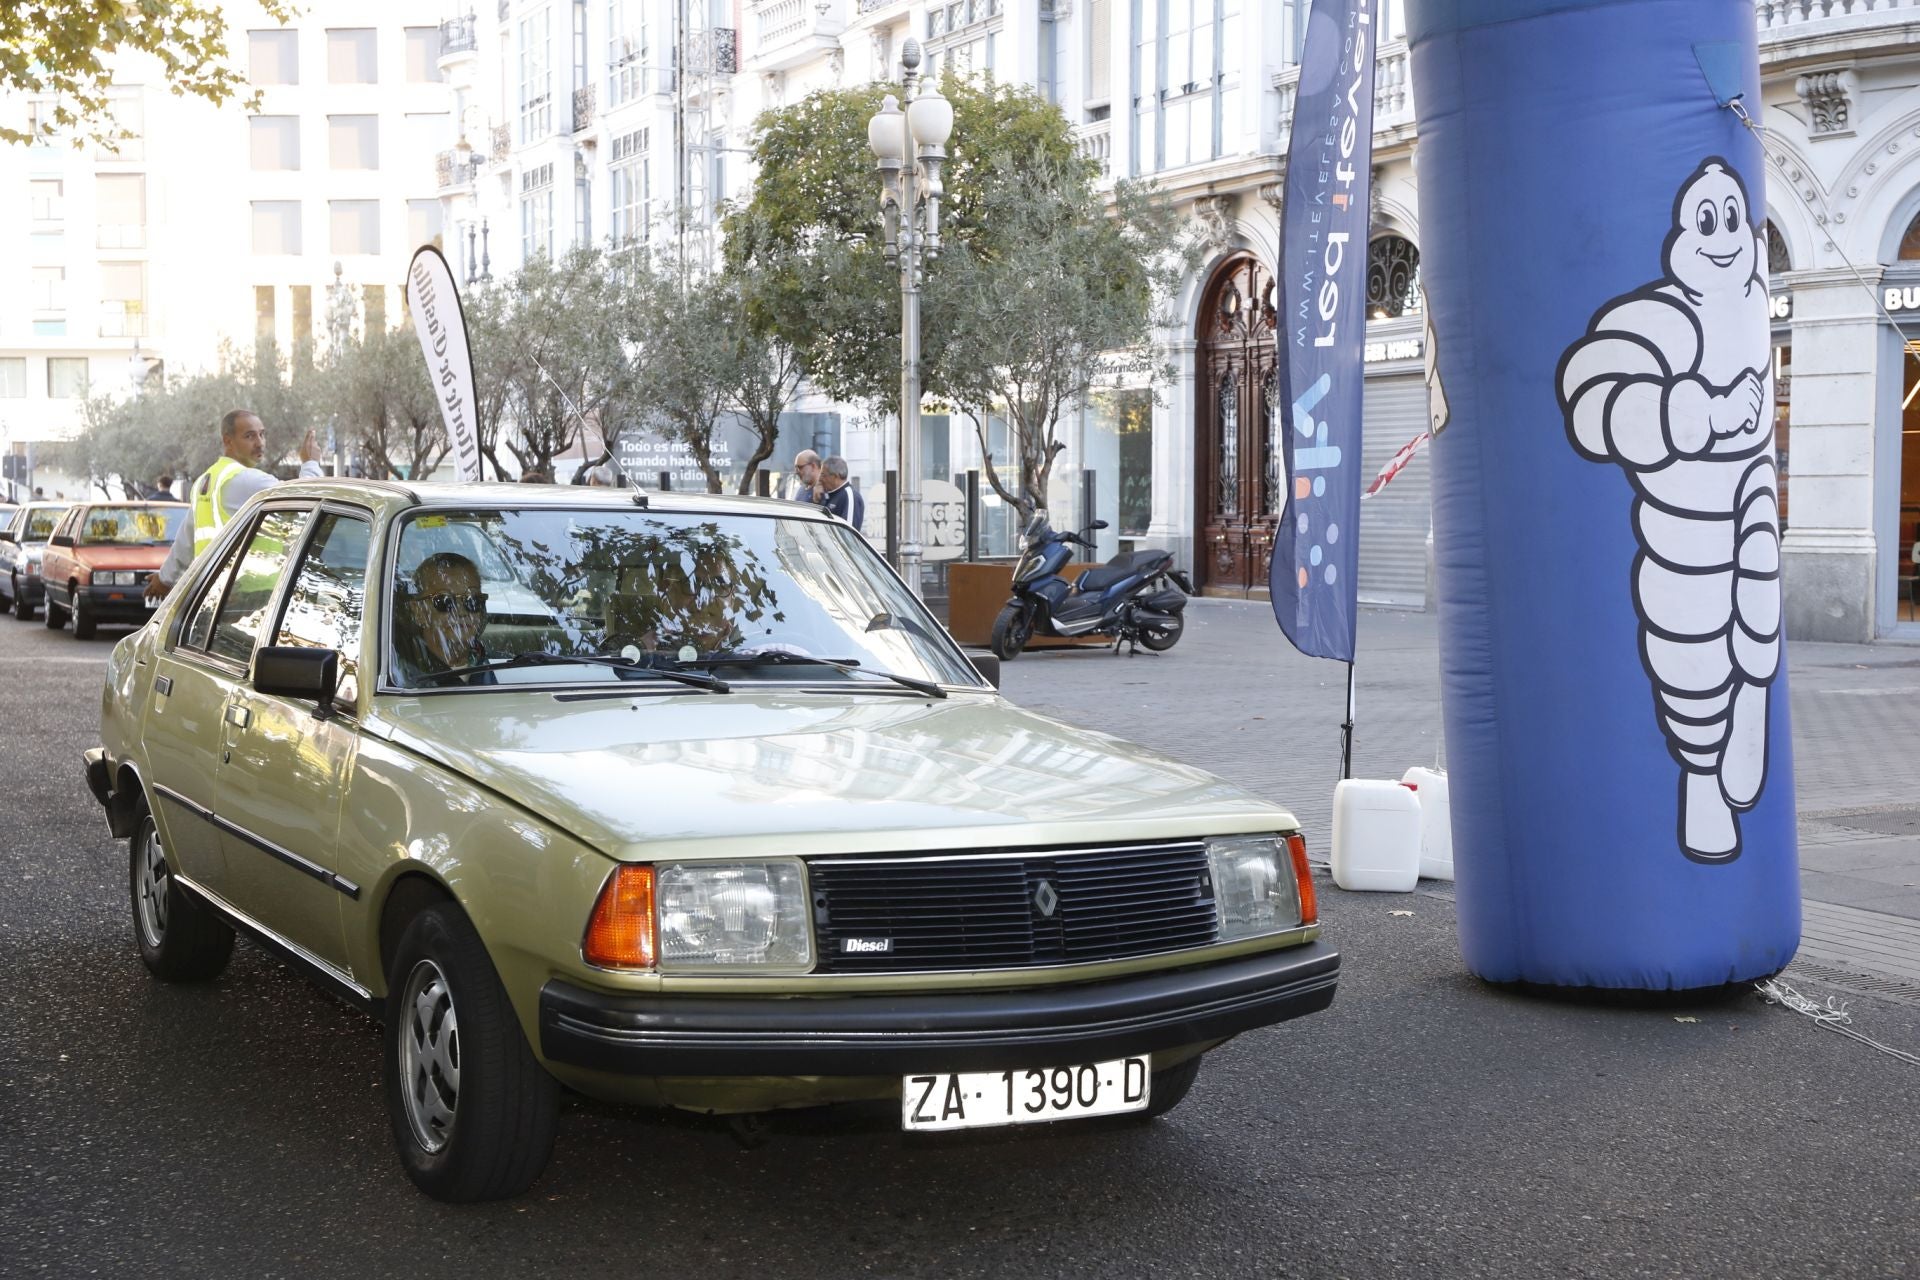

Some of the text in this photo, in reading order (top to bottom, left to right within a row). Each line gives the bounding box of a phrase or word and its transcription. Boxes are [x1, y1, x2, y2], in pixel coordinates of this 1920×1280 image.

[620, 440, 651, 453] Todo
[654, 443, 668, 453] es
[621, 454, 667, 467] cuando
[635, 469, 677, 481] miso
[921, 522, 966, 545] ING
[846, 938, 889, 953] Diesel
